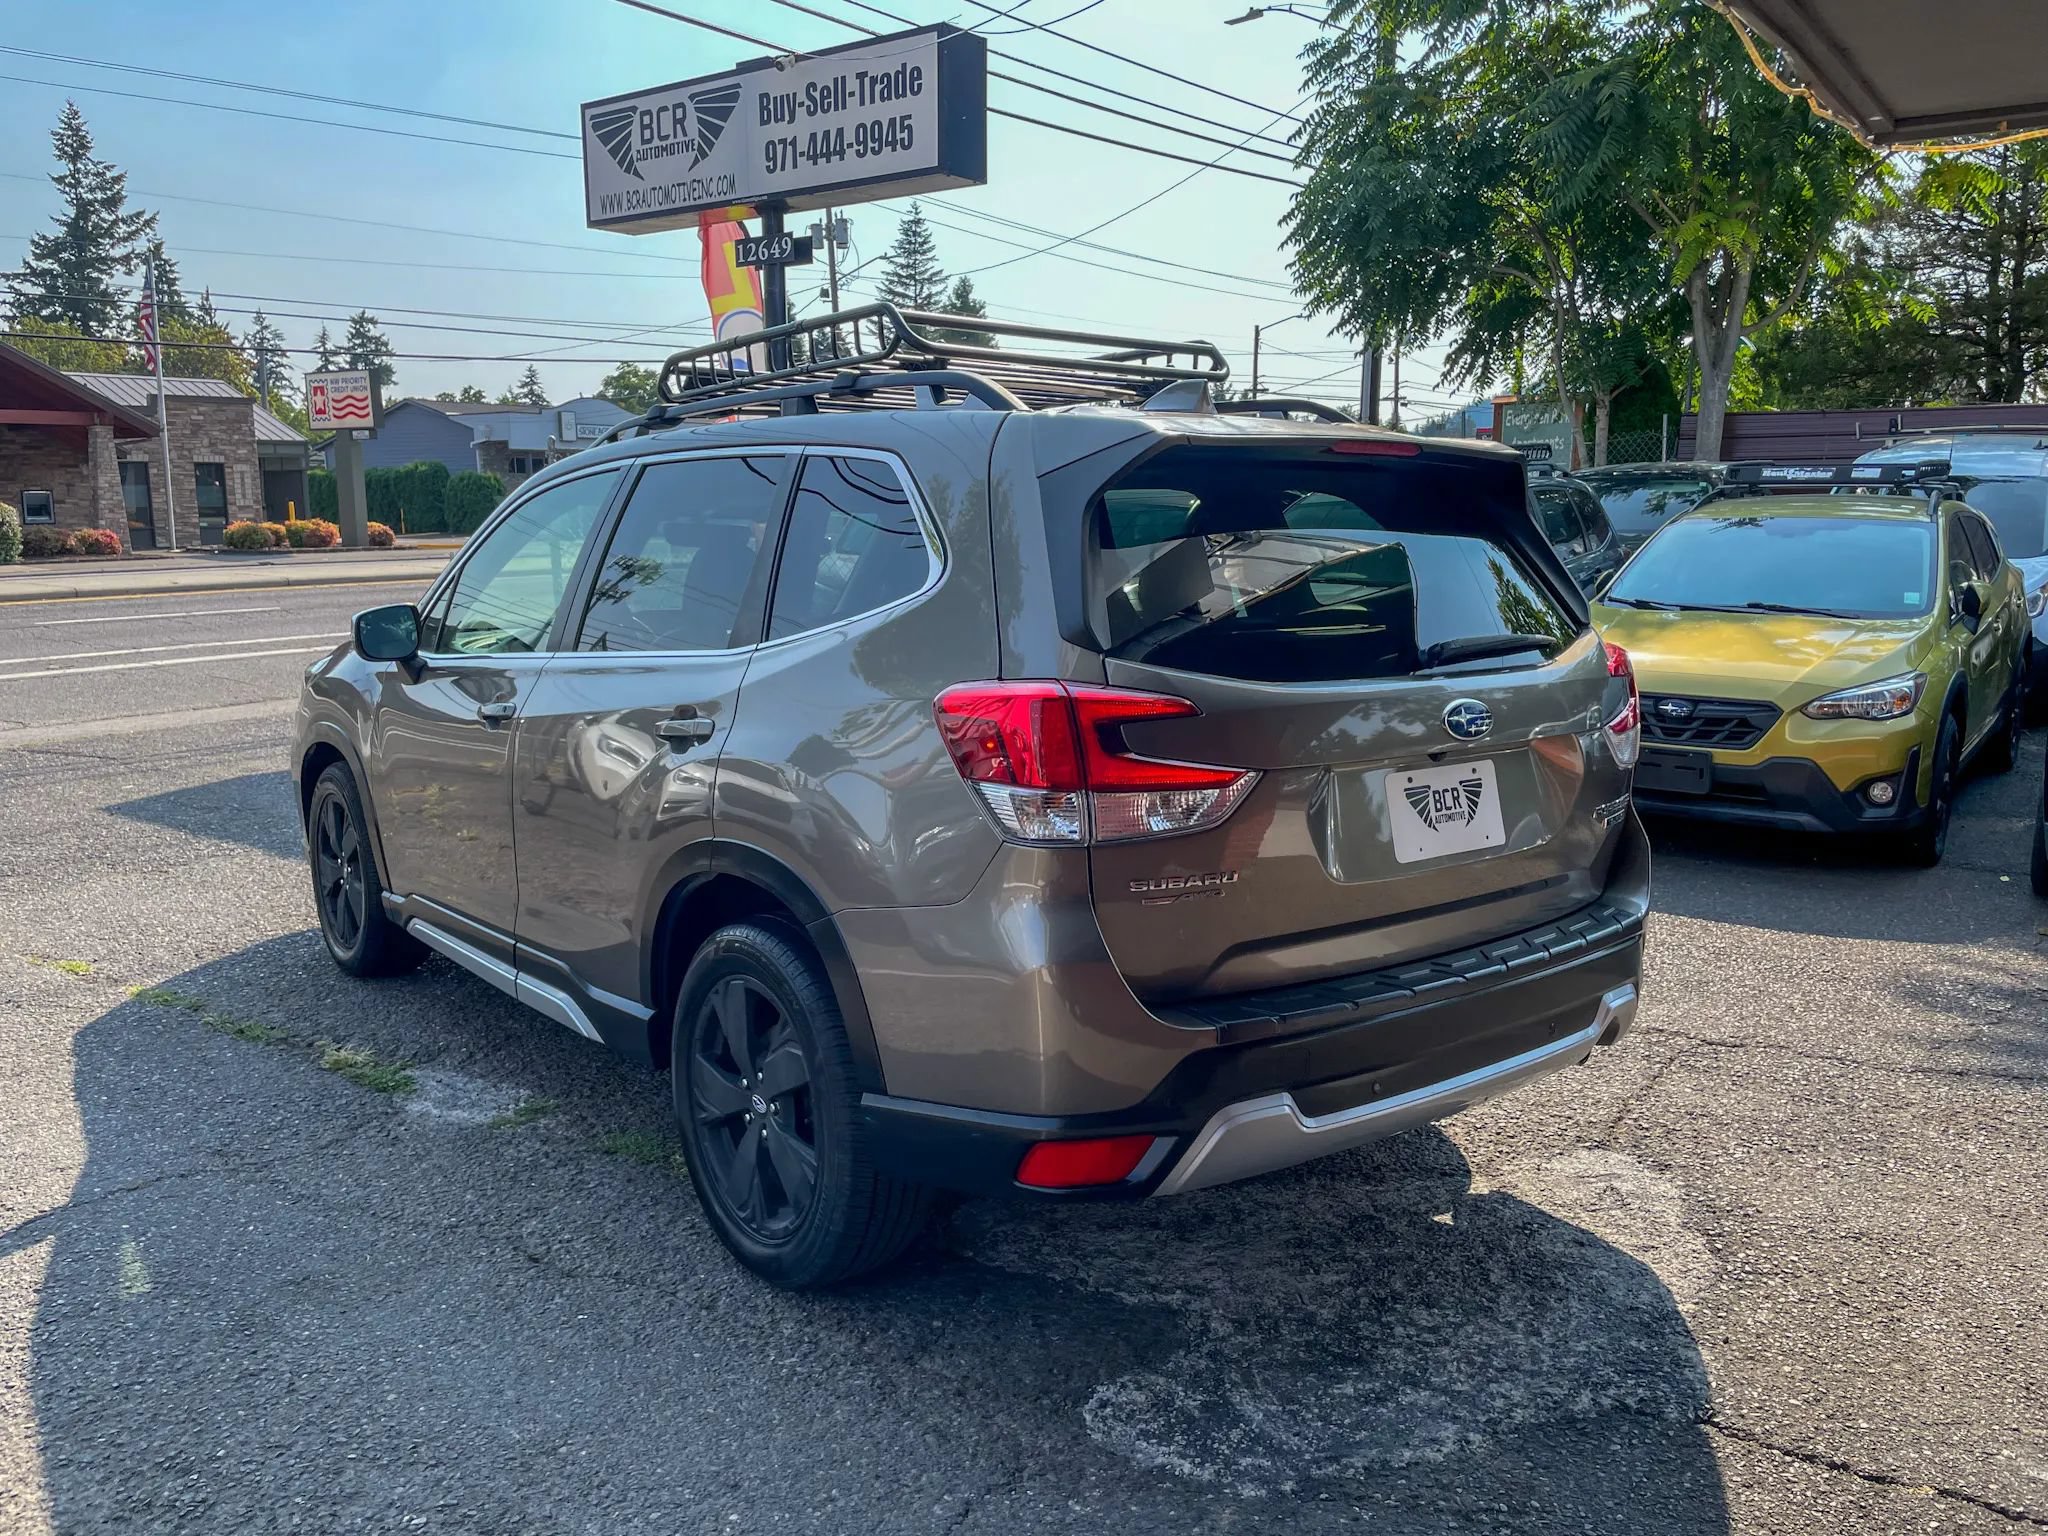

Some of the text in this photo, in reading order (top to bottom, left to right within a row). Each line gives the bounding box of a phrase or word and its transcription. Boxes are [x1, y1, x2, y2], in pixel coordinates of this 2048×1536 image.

[758, 62, 923, 127] Buy-Sell-Trade
[639, 101, 688, 146] BCR
[635, 138, 696, 163] AUTOMOTIVE
[765, 113, 914, 175] 971-444-9945
[600, 173, 737, 215] WWW.BCRAUTOMOTIVEINC.COM
[737, 236, 792, 263] 12649
[330, 385, 368, 393] CREDIT UNION
[341, 375, 368, 385] PRIORITY
[1432, 787, 1463, 813] BCR
[1434, 810, 1467, 824] AUTOMOTIVE
[1129, 870, 1239, 892] SUBARU
